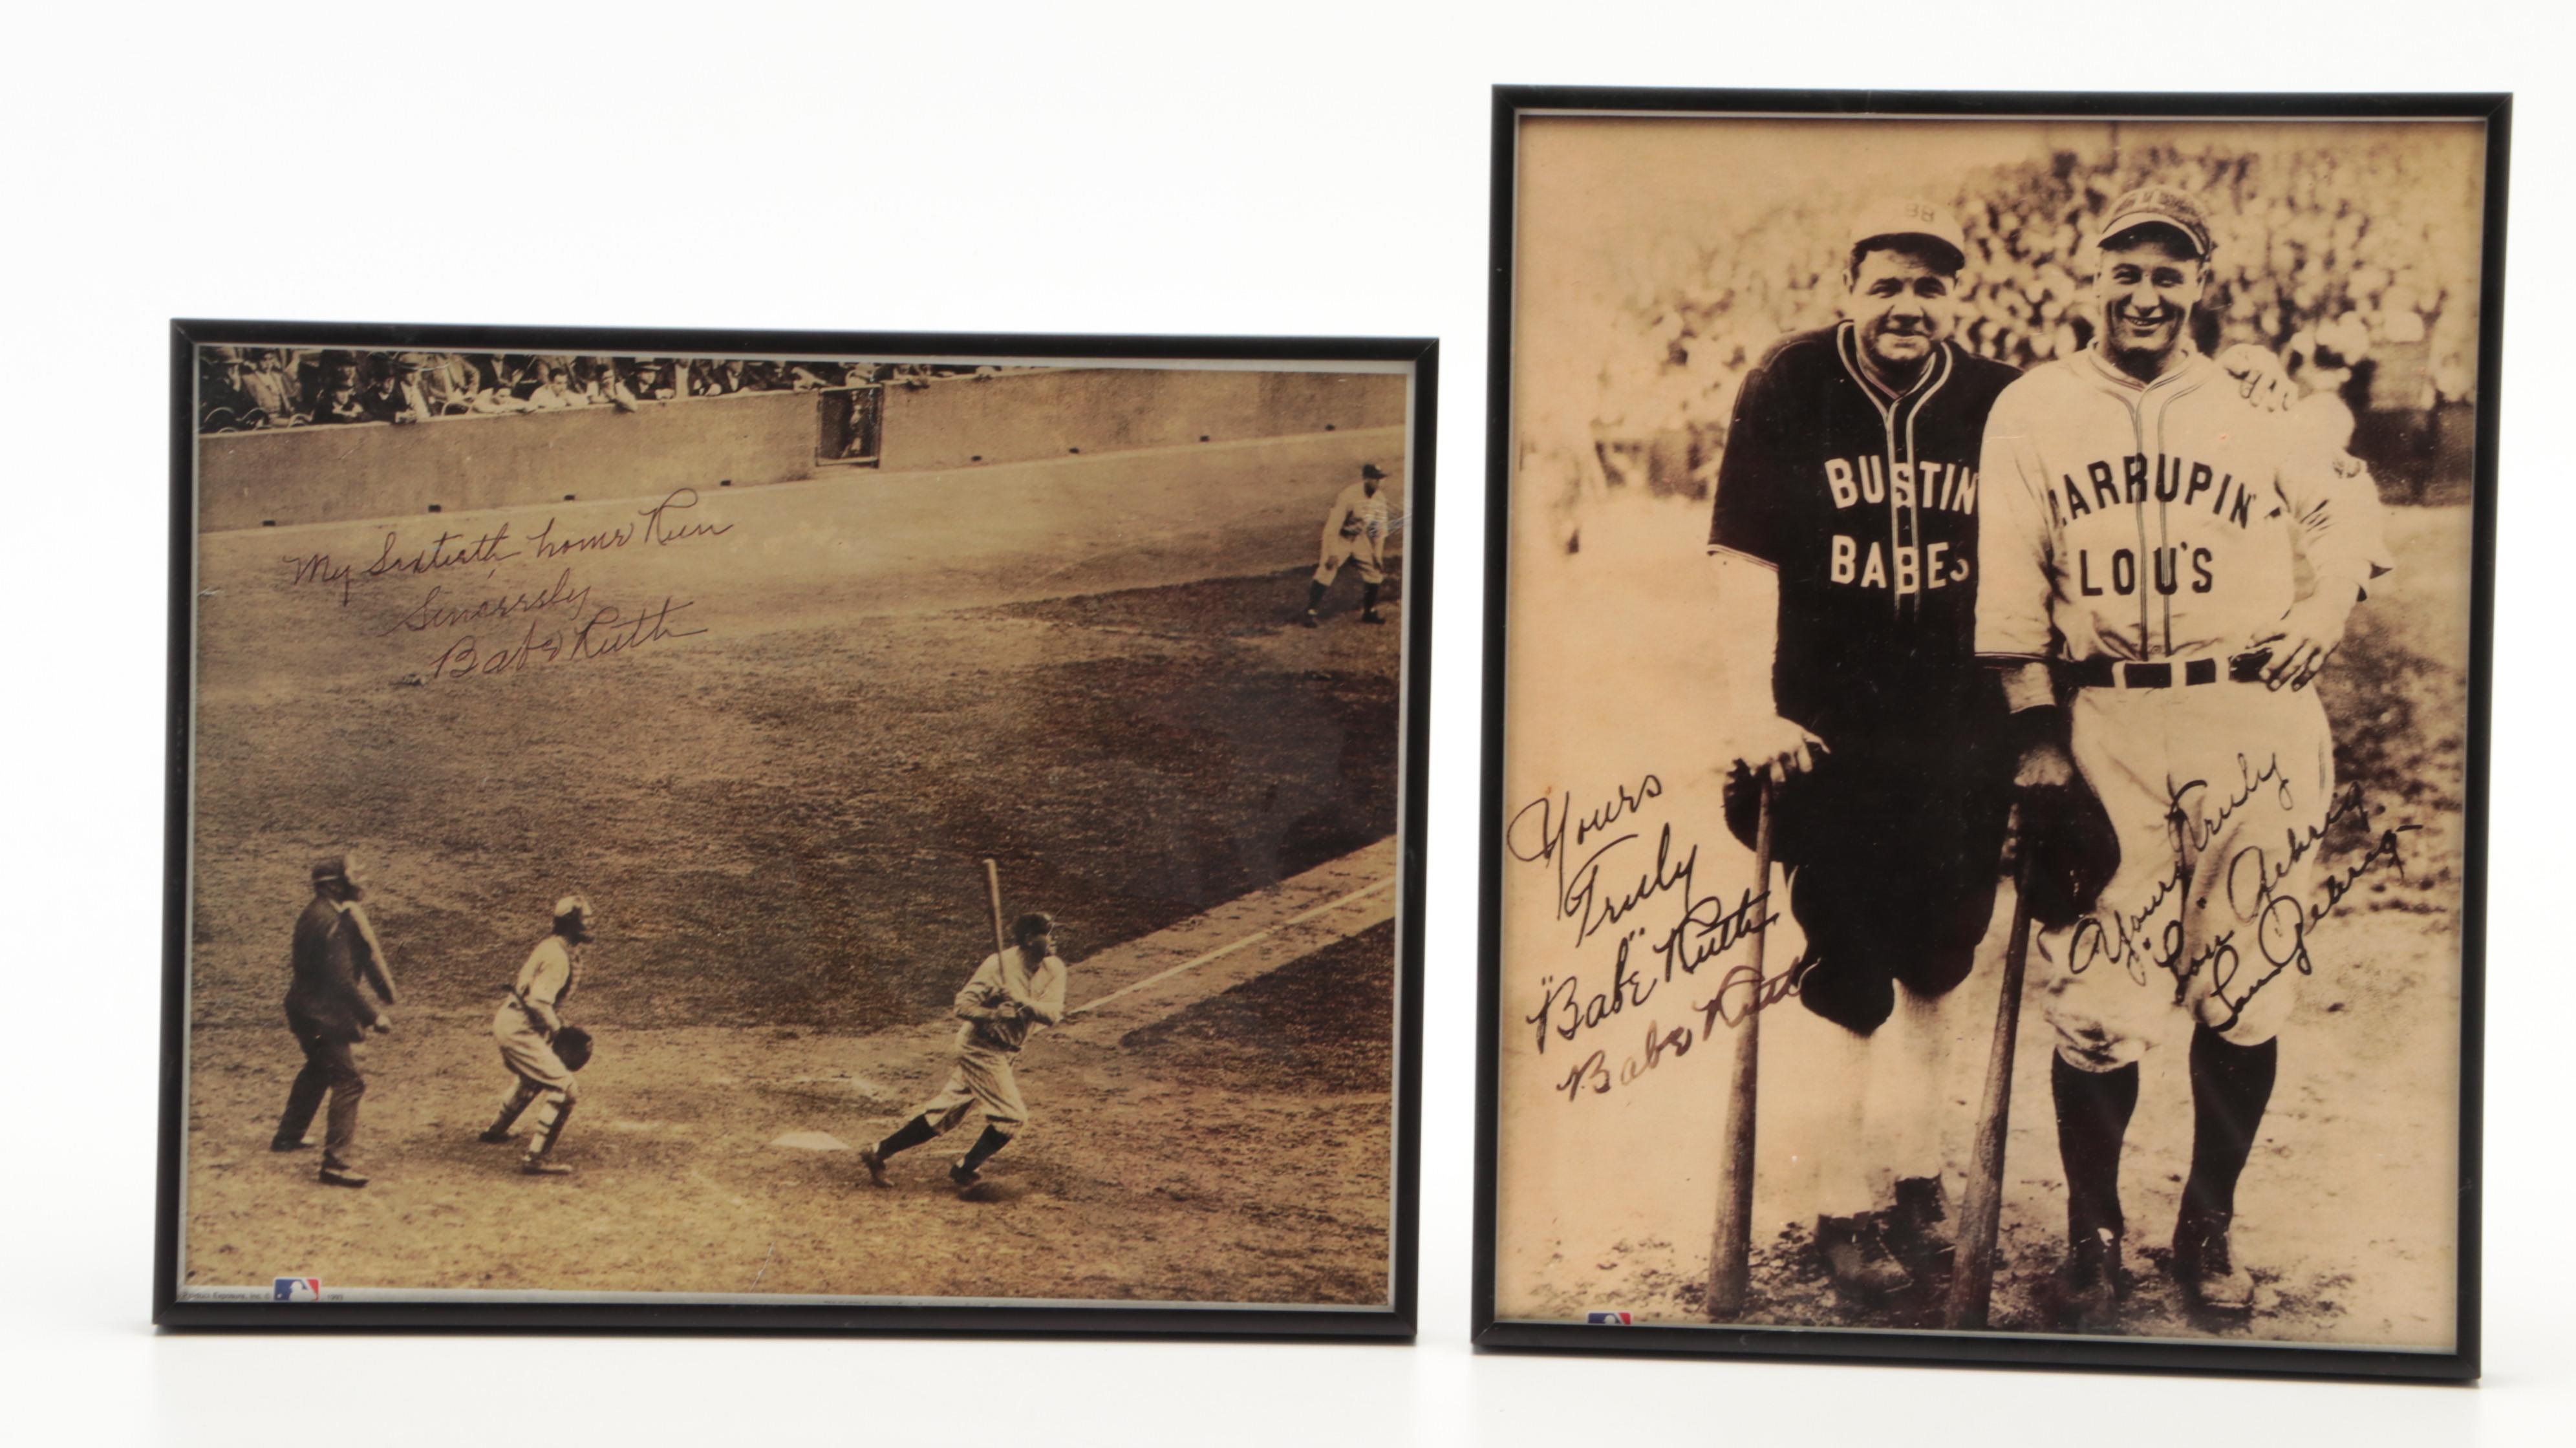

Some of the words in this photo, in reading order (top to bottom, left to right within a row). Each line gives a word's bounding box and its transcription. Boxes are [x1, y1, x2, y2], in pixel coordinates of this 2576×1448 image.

[282, 553, 351, 608] My
[528, 518, 634, 559] home
[638, 487, 733, 544] Run
[376, 567, 592, 638] Sincerely
[2080, 541, 2213, 596] LOU'S
[429, 619, 563, 679] Babe
[569, 598, 708, 661] Ruth
[1507, 774, 1662, 921] Yours
[1563, 822, 1697, 949] Truly
[2069, 860, 2184, 987] Yours
[2165, 751, 2293, 852] Truly
[2226, 781, 2371, 937] Gehrig
[1653, 888, 1780, 983] Ruth
[2209, 944, 2282, 1032] Lou
[2259, 824, 2423, 975] Gehrig
[1556, 1019, 1693, 1102] Babe
[1692, 957, 1820, 1041] Ruth
